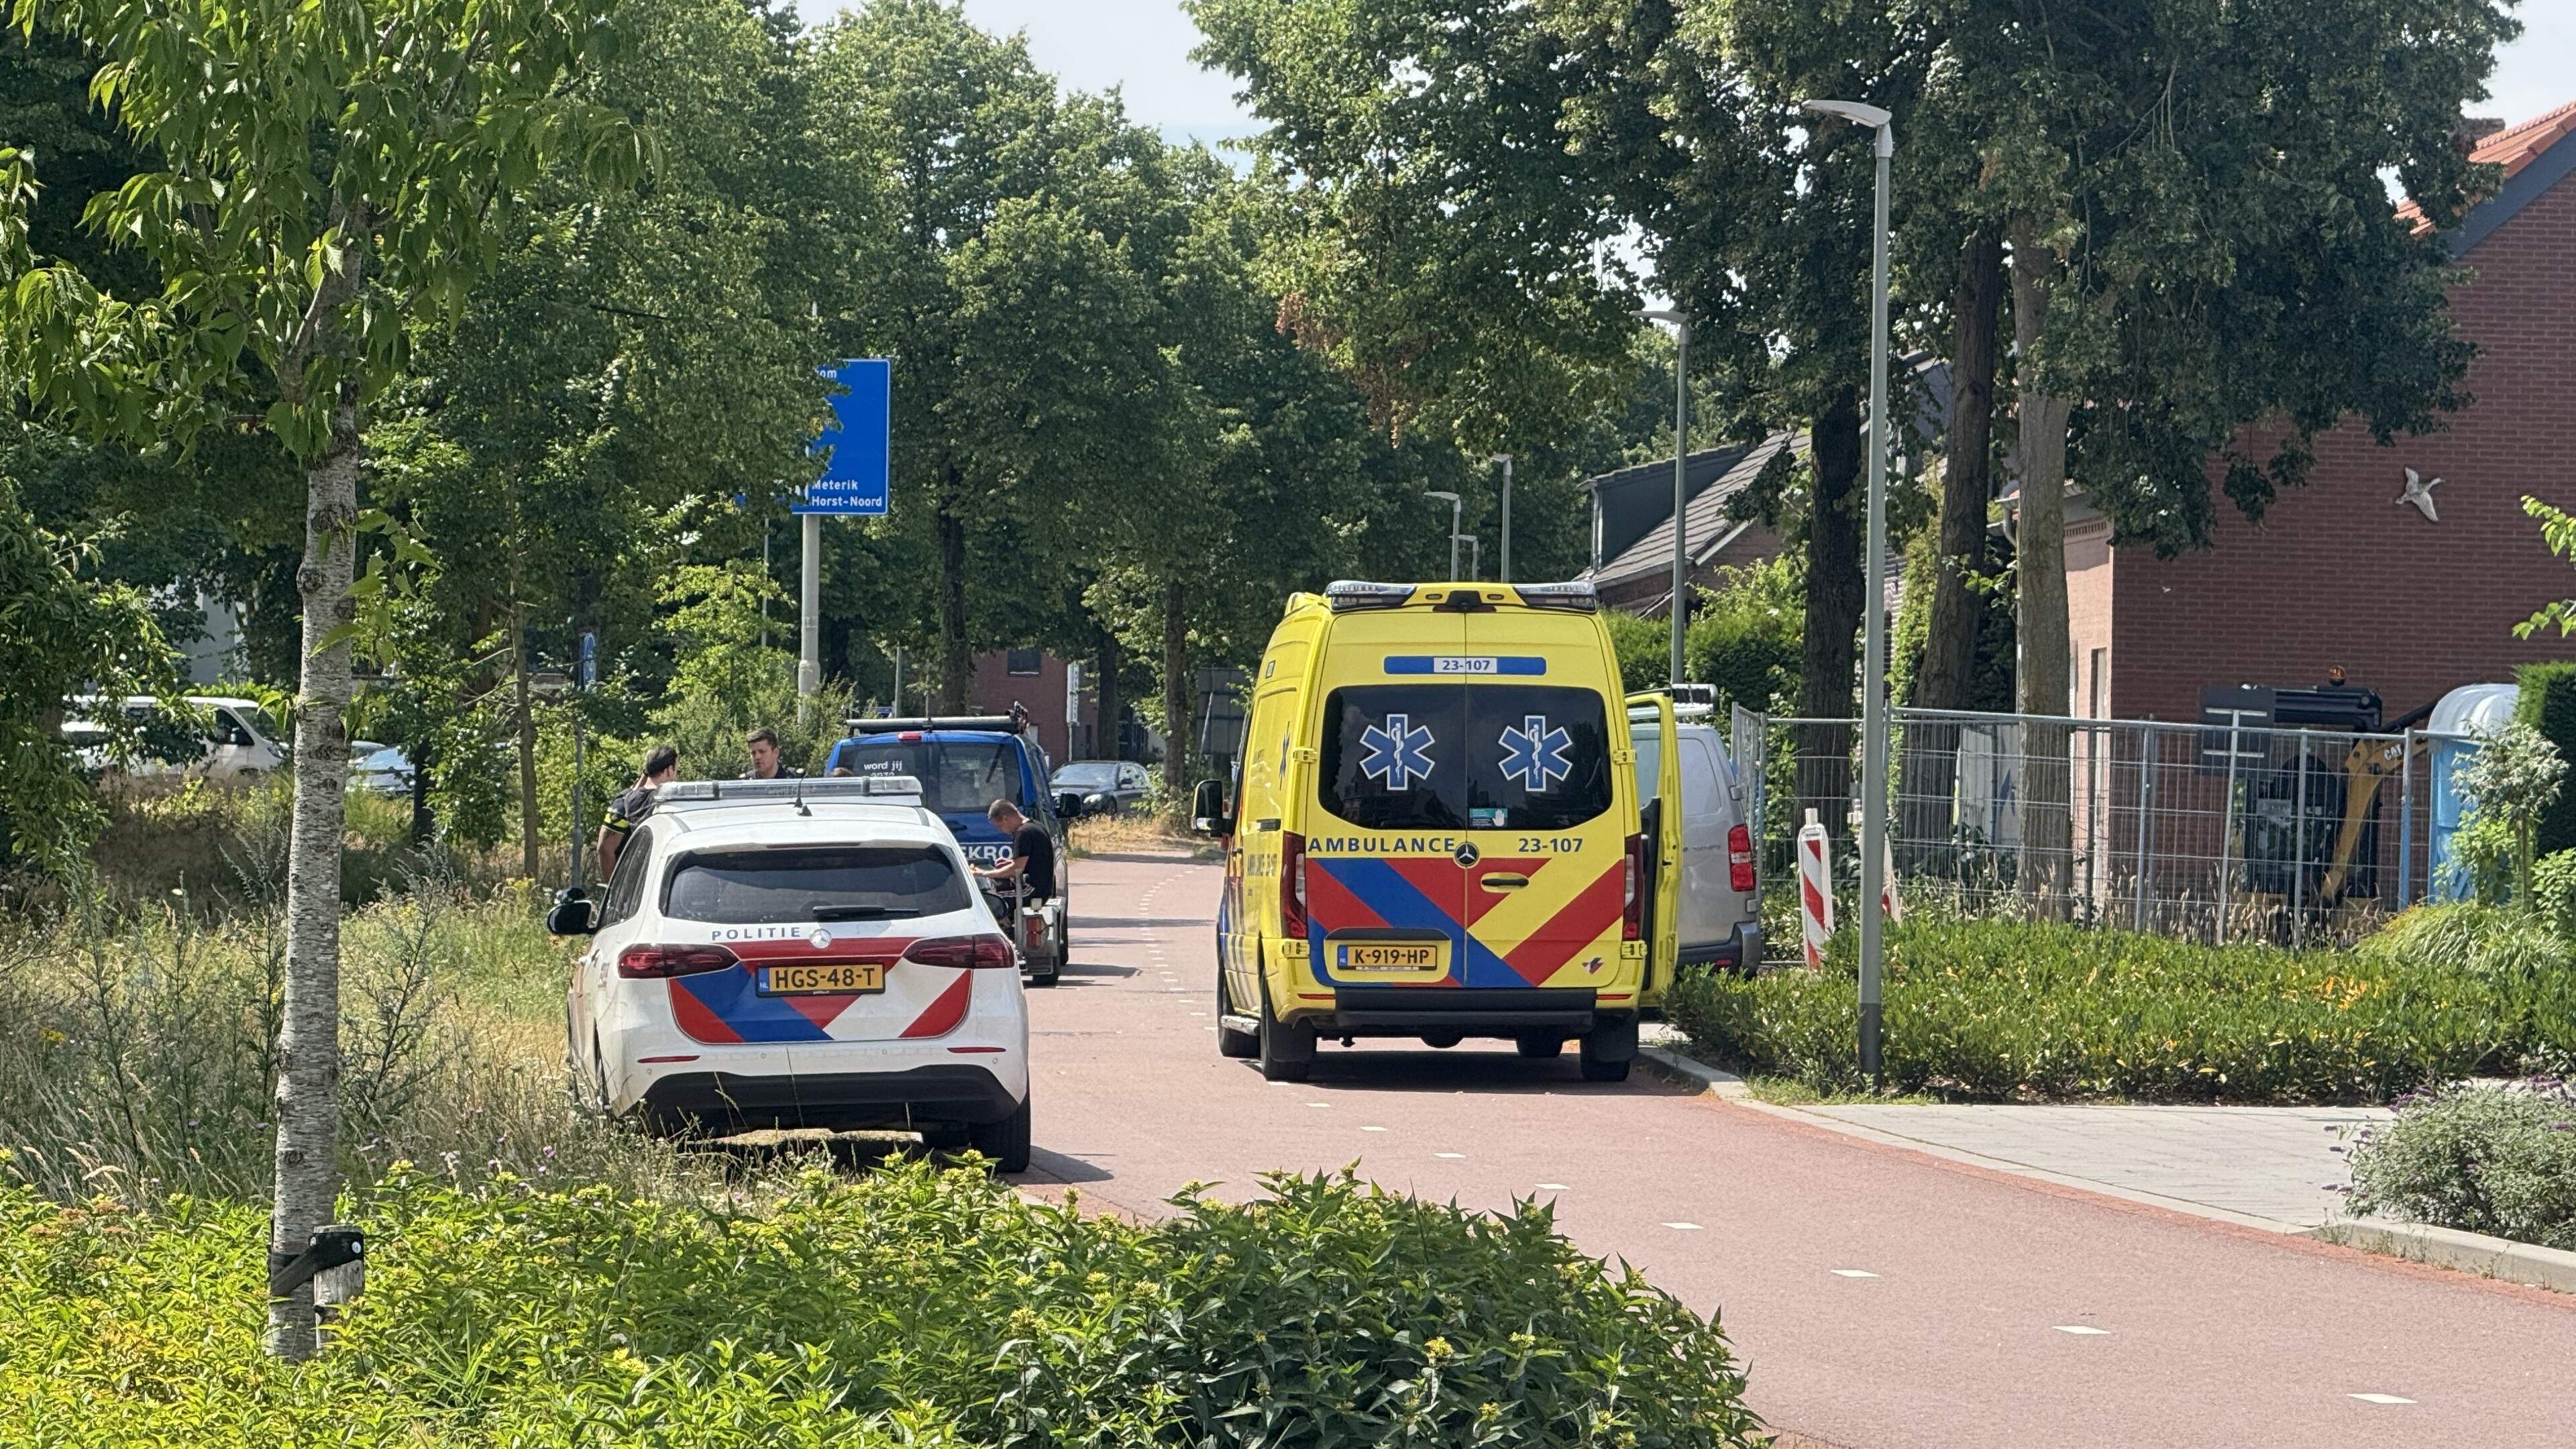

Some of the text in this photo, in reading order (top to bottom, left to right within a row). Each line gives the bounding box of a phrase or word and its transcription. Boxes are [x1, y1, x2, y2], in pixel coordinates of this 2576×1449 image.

[812, 480, 858, 490] Meterik
[812, 496, 882, 506] Horst-Noord
[1442, 660, 1490, 670] 23-107
[2383, 744, 2402, 761] CAT
[864, 760, 902, 771] word jij
[1308, 837, 1456, 853] AMBULANCE
[1518, 838, 1583, 853] 23-107
[712, 927, 800, 941] POLITIE
[1354, 949, 1429, 964] K-919-HP
[775, 967, 875, 989] HGS-48-T
